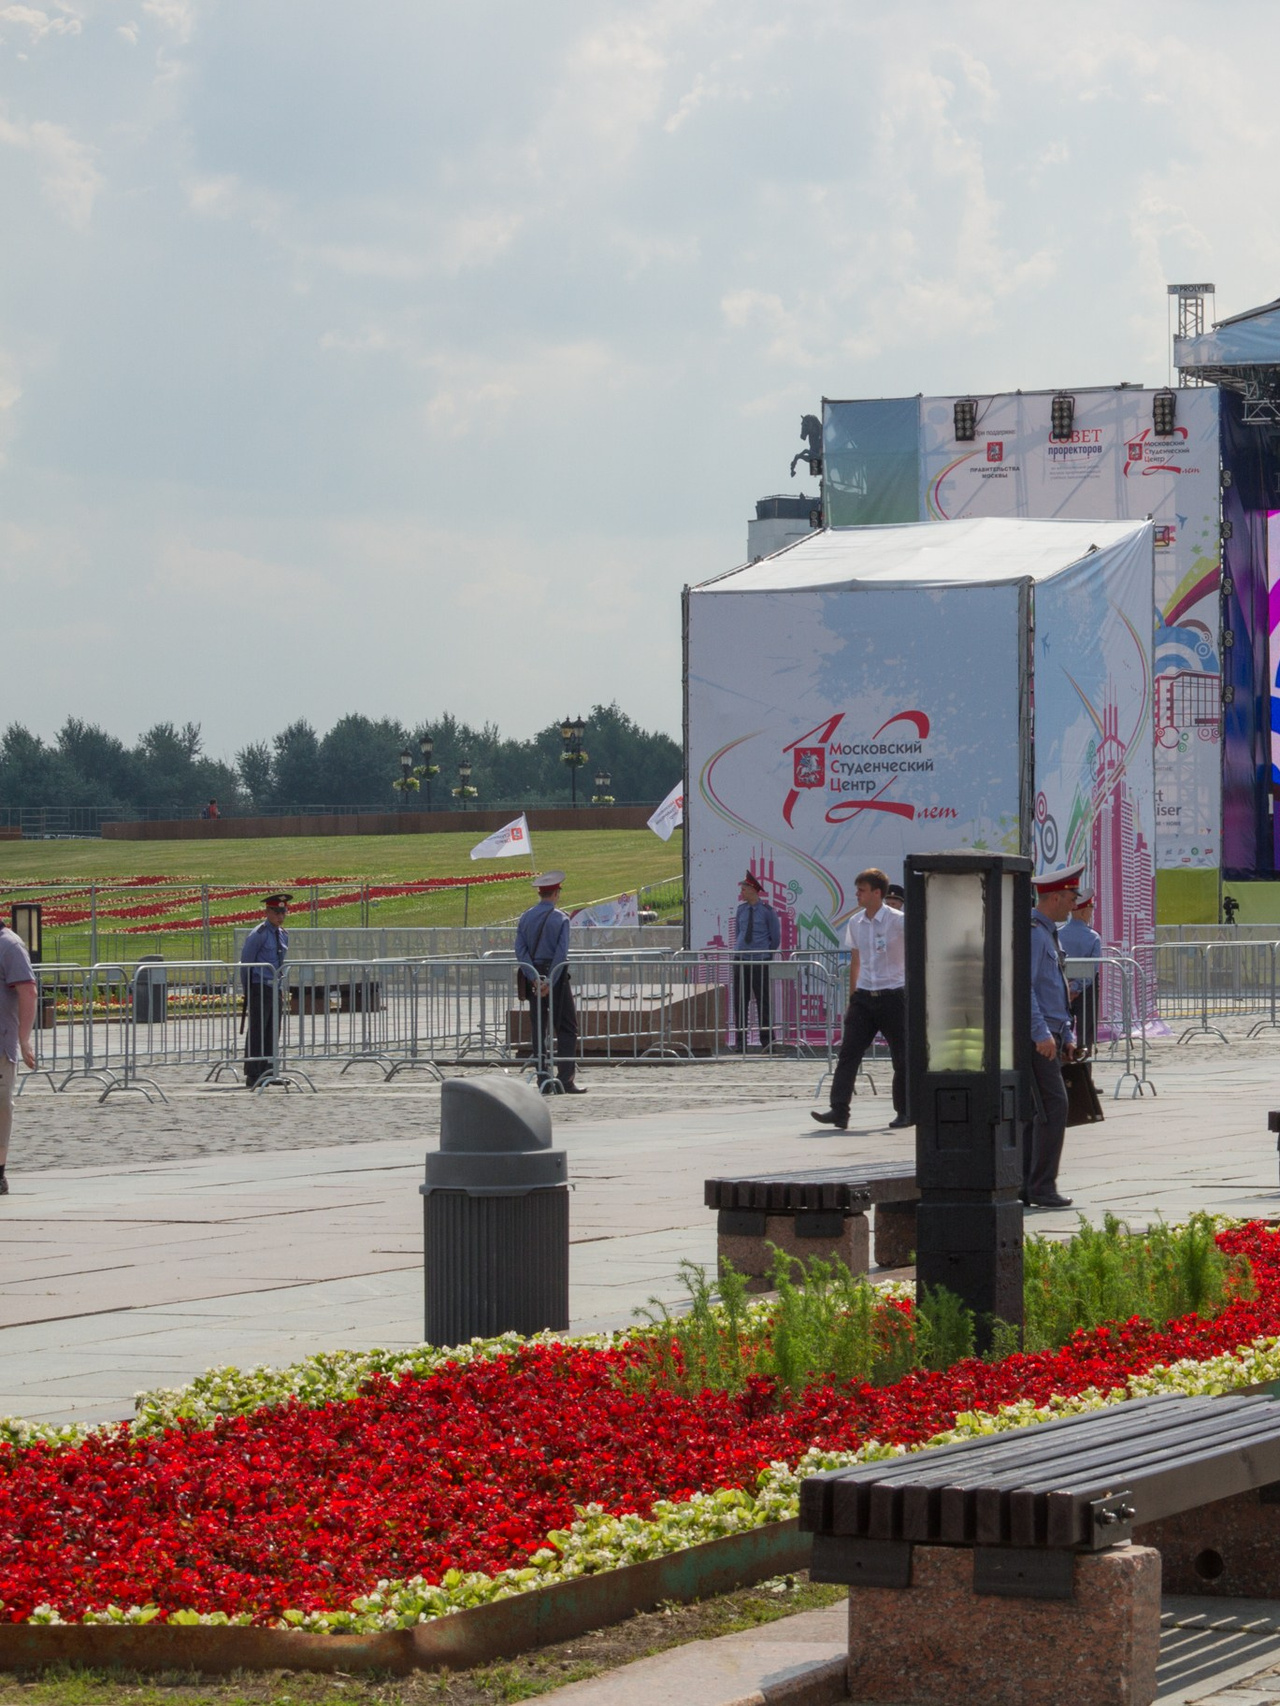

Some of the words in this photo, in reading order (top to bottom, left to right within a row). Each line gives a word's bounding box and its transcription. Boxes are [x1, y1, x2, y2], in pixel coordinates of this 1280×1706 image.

[1048, 445, 1103, 462] проректоров
[1144, 447, 1190, 455] Студенческий
[829, 740, 923, 756] Московский
[830, 758, 935, 776] Студенческий
[829, 778, 876, 793] Центр
[917, 805, 959, 820] лет
